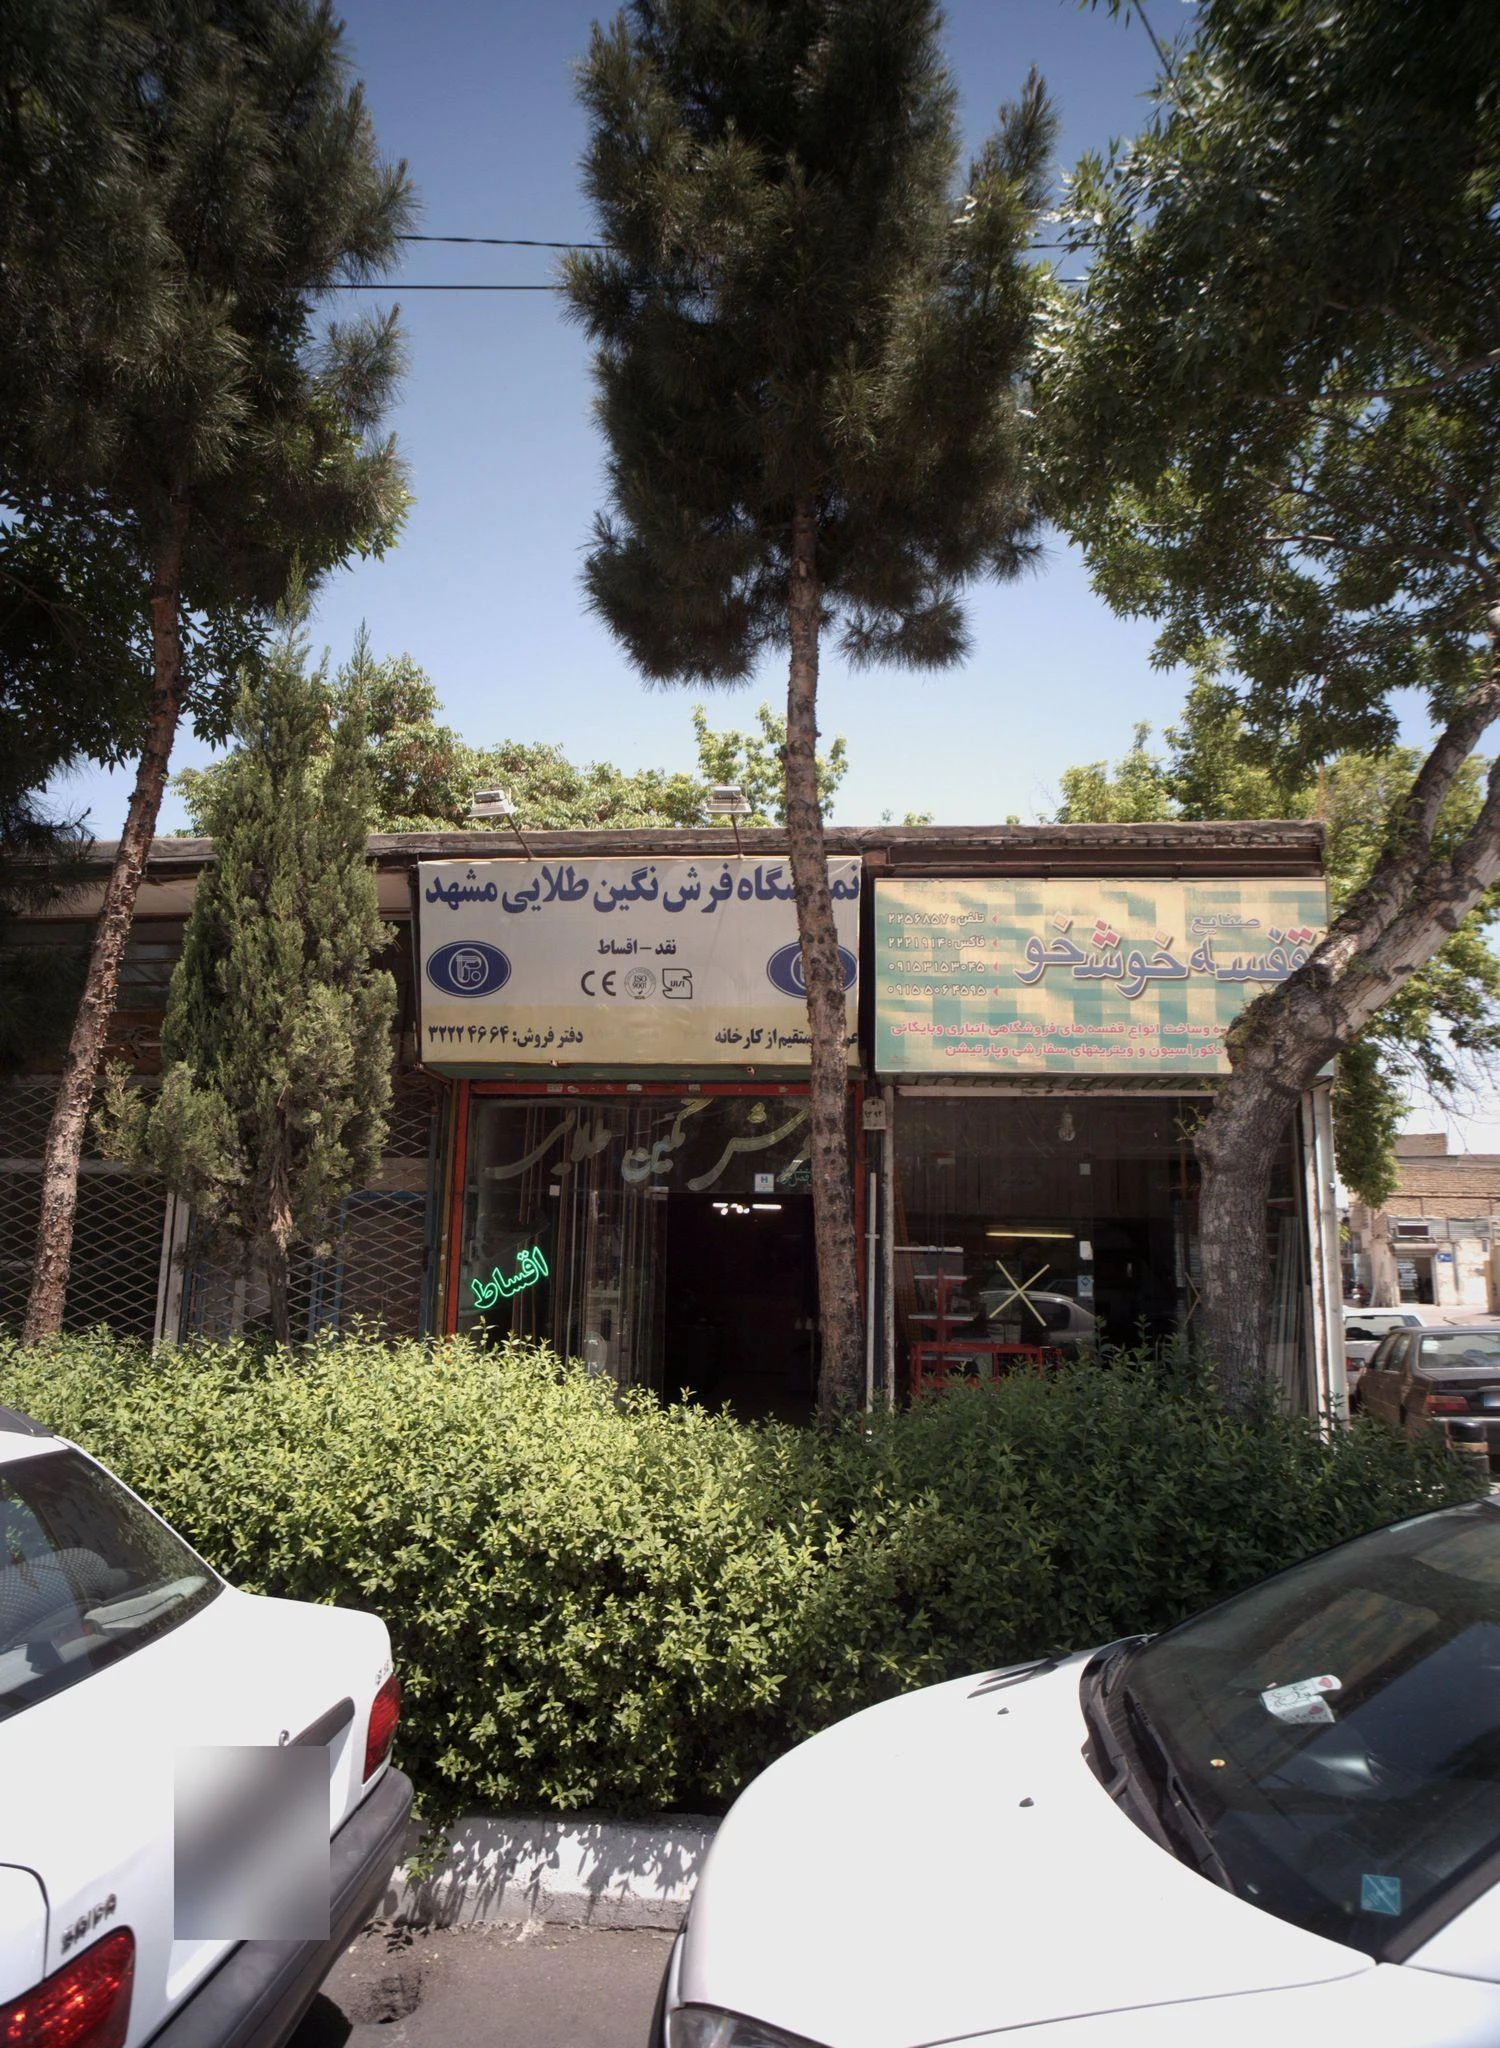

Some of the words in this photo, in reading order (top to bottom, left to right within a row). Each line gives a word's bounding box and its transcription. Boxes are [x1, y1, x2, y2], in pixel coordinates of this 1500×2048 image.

[425, 868, 498, 911] مشهد
[501, 865, 590, 914] طلایی
[593, 864, 659, 913] نگین
[662, 862, 733, 913] فرش
[737, 864, 860, 901] نمگاه
[1191, 913, 1261, 935] صنایع
[597, 938, 637, 955] اقساط
[655, 939, 677, 955] نقد
[1012, 911, 1190, 998] خوشخو
[556, 1026, 584, 1049] دفتر
[765, 1028, 777, 1049] از
[1087, 1021, 1125, 1035] قفسه
[1127, 1023, 1160, 1040] انواع
[471, 1246, 549, 1309] اقساط
